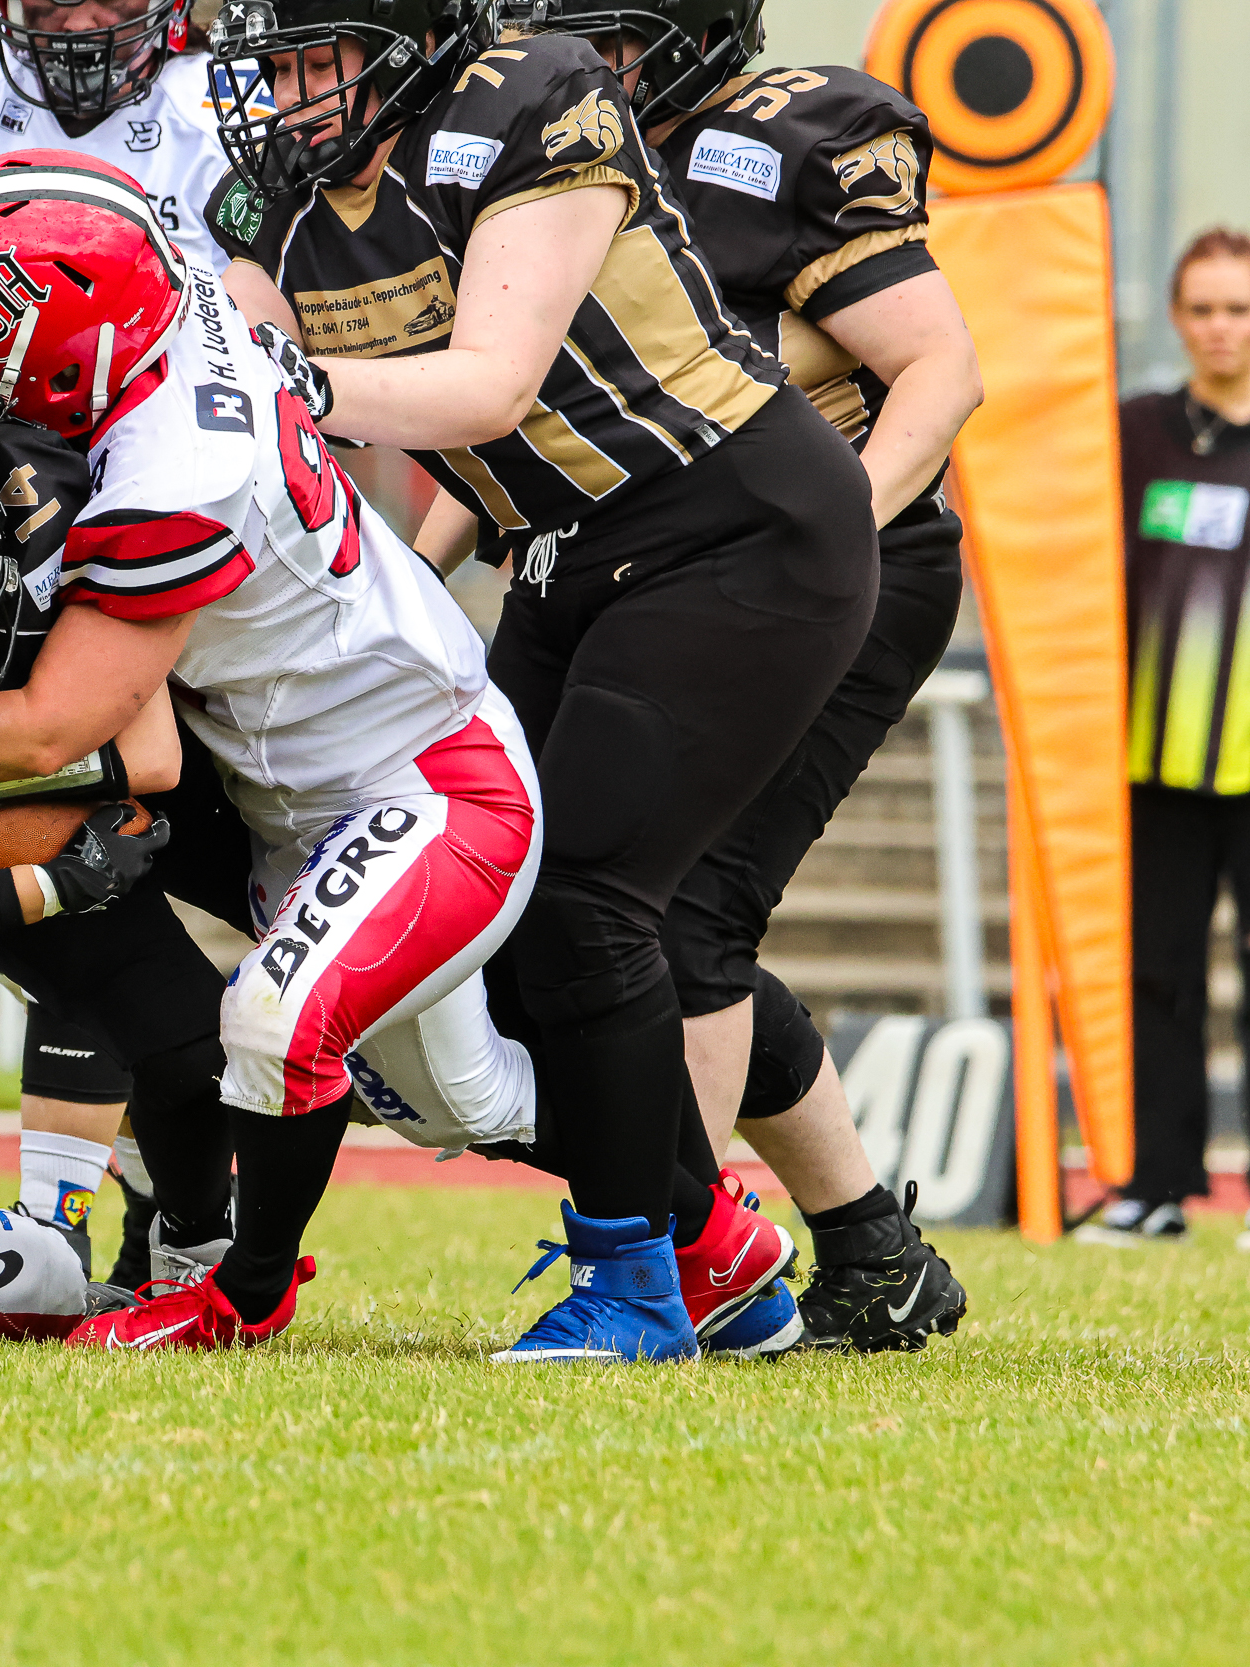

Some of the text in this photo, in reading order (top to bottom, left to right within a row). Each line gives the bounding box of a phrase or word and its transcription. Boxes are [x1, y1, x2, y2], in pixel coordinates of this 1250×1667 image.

[453, 49, 529, 93] 71
[1, 114, 24, 134] GFL
[695, 146, 774, 179] MERCATUS
[192, 273, 237, 382] H. Luderer
[261, 806, 419, 1004] BEGRO
[841, 1015, 1010, 1220] 40
